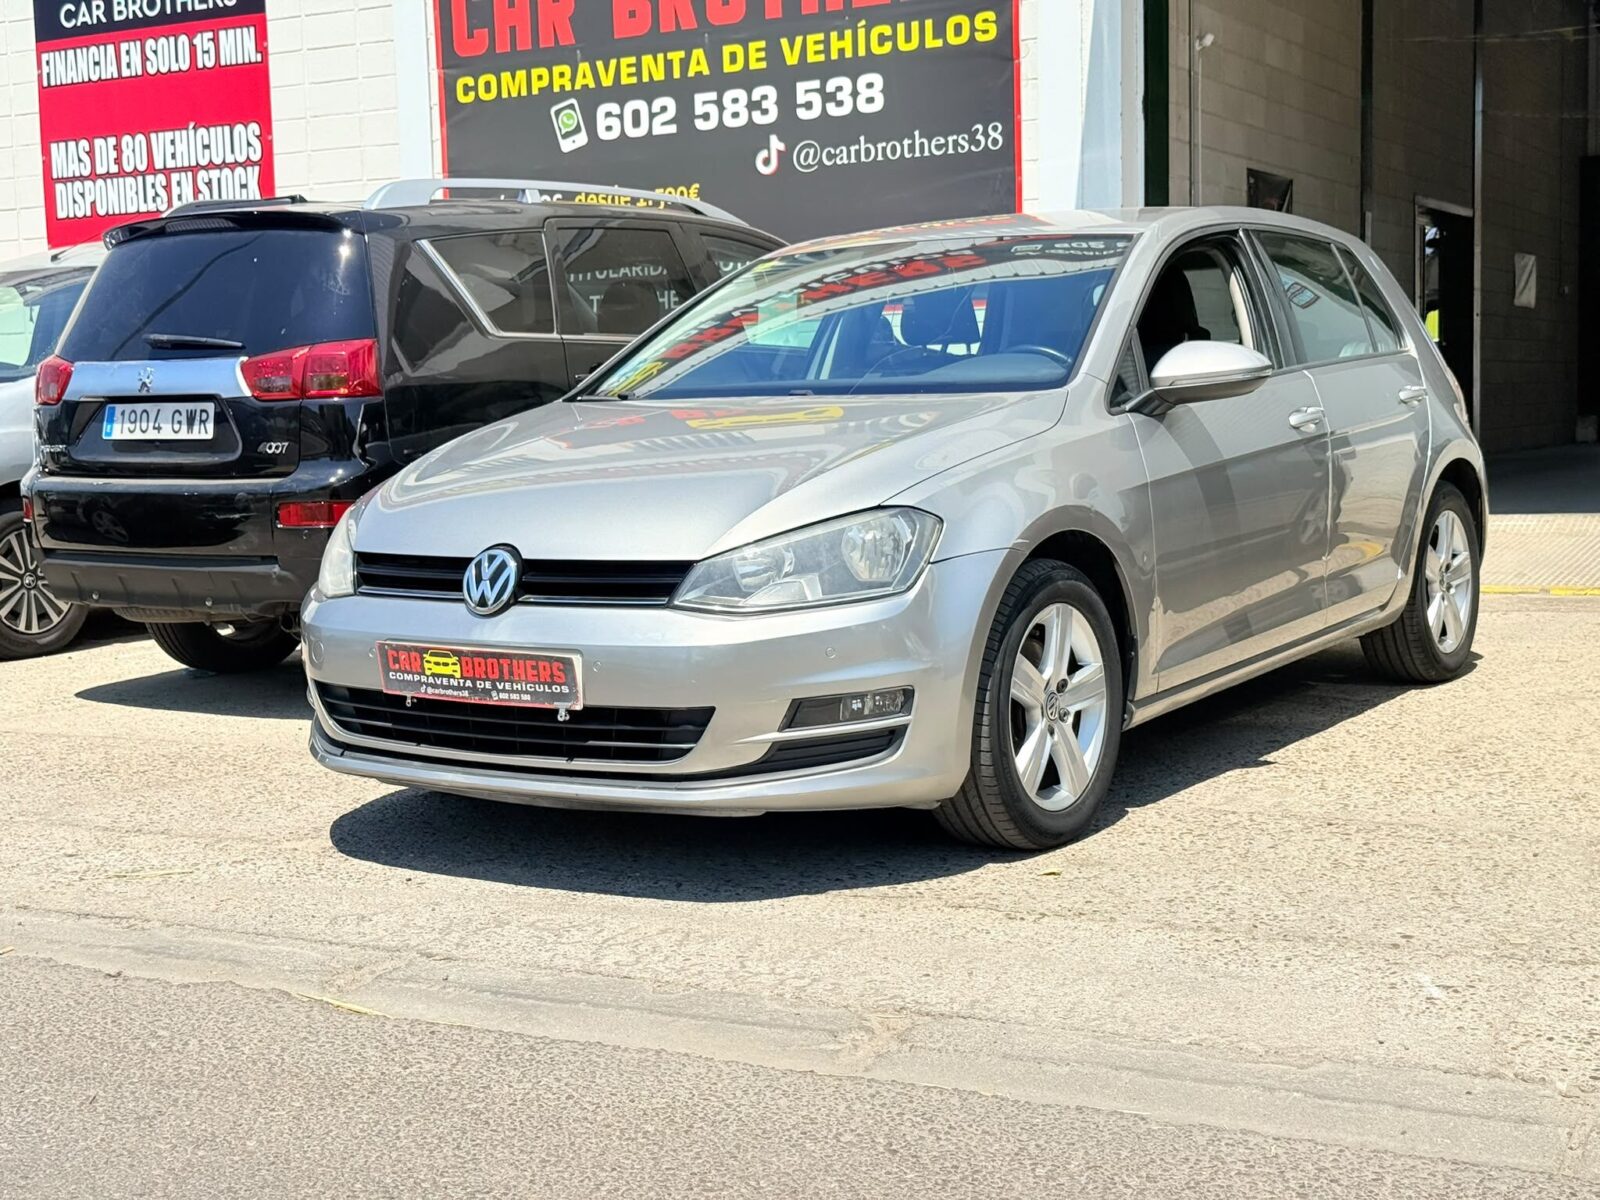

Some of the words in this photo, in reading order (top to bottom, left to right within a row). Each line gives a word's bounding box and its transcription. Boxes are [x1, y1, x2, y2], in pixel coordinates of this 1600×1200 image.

[60, 0, 106, 28] CAR
[451, 0, 576, 57] CAR
[41, 43, 119, 87] FINANCIA
[120, 40, 144, 77] EN
[144, 33, 190, 75] SOLO
[193, 31, 215, 69] 15
[218, 26, 262, 65] MIN.
[456, 48, 710, 104] COMPRAVENTA
[721, 40, 768, 74] DE
[780, 10, 998, 66] VEHÍCULOS
[595, 96, 678, 141] 602
[694, 85, 779, 131] 583
[796, 73, 885, 120] 538
[50, 139, 91, 179] MAS
[93, 136, 119, 175] DE
[121, 133, 149, 173] 80
[149, 122, 262, 170] VEHÍCULOS
[792, 122, 1004, 173] @carbrothers38
[55, 173, 169, 219] DISPONIBLES
[170, 170, 195, 208] EN
[196, 166, 262, 201] STOCK
[120, 408, 162, 434] 1904
[171, 408, 210, 434] GWR
[463, 549, 517, 614] VW
[387, 649, 422, 672] CAR
[460, 655, 566, 683] BROTHERS
[389, 672, 472, 688] COMPRAVENTA
[477, 681, 492, 689] DE
[496, 681, 570, 693] VEHÍCULOS
